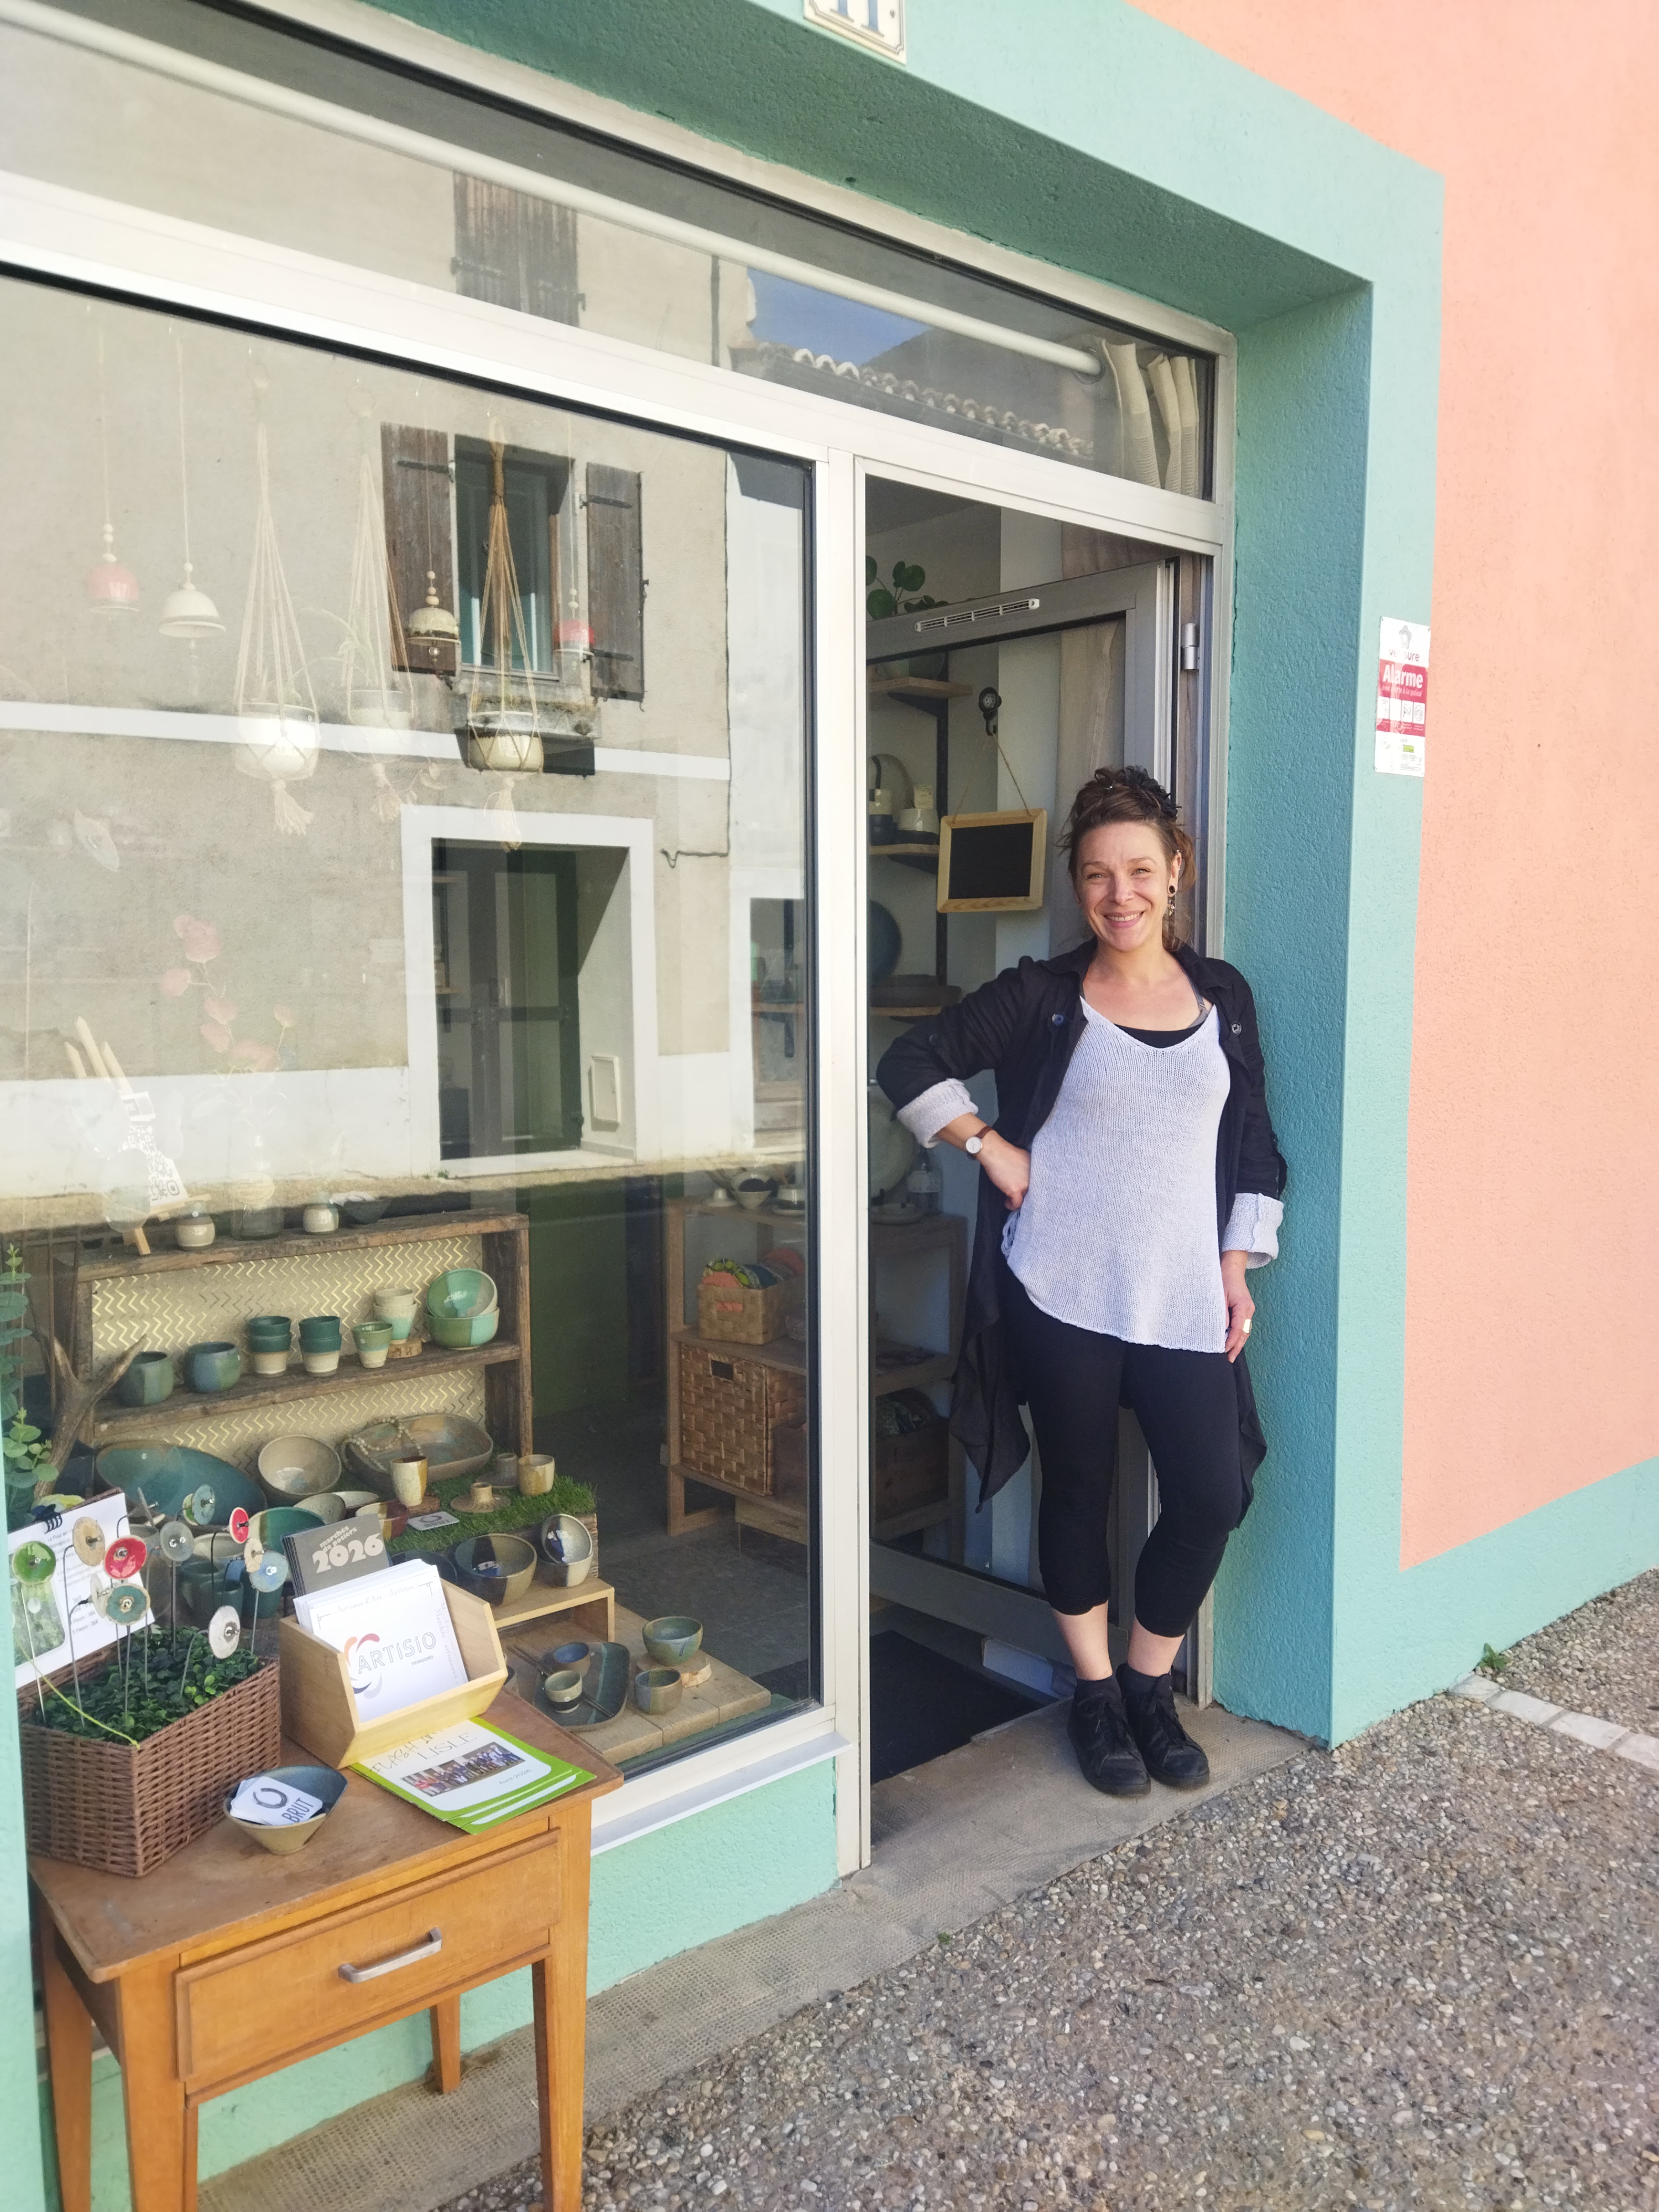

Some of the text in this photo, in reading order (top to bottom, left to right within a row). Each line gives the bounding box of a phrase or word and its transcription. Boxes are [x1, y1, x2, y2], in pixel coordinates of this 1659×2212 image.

[1389, 648, 1420, 662] vesure
[1383, 664, 1423, 688] Alarme
[320, 1525, 349, 1548] marchés
[332, 1527, 357, 1547] potiers
[312, 1532, 384, 1573] 2026
[417, 1732, 477, 1760] LISLE
[281, 1798, 314, 1823] BRUT
